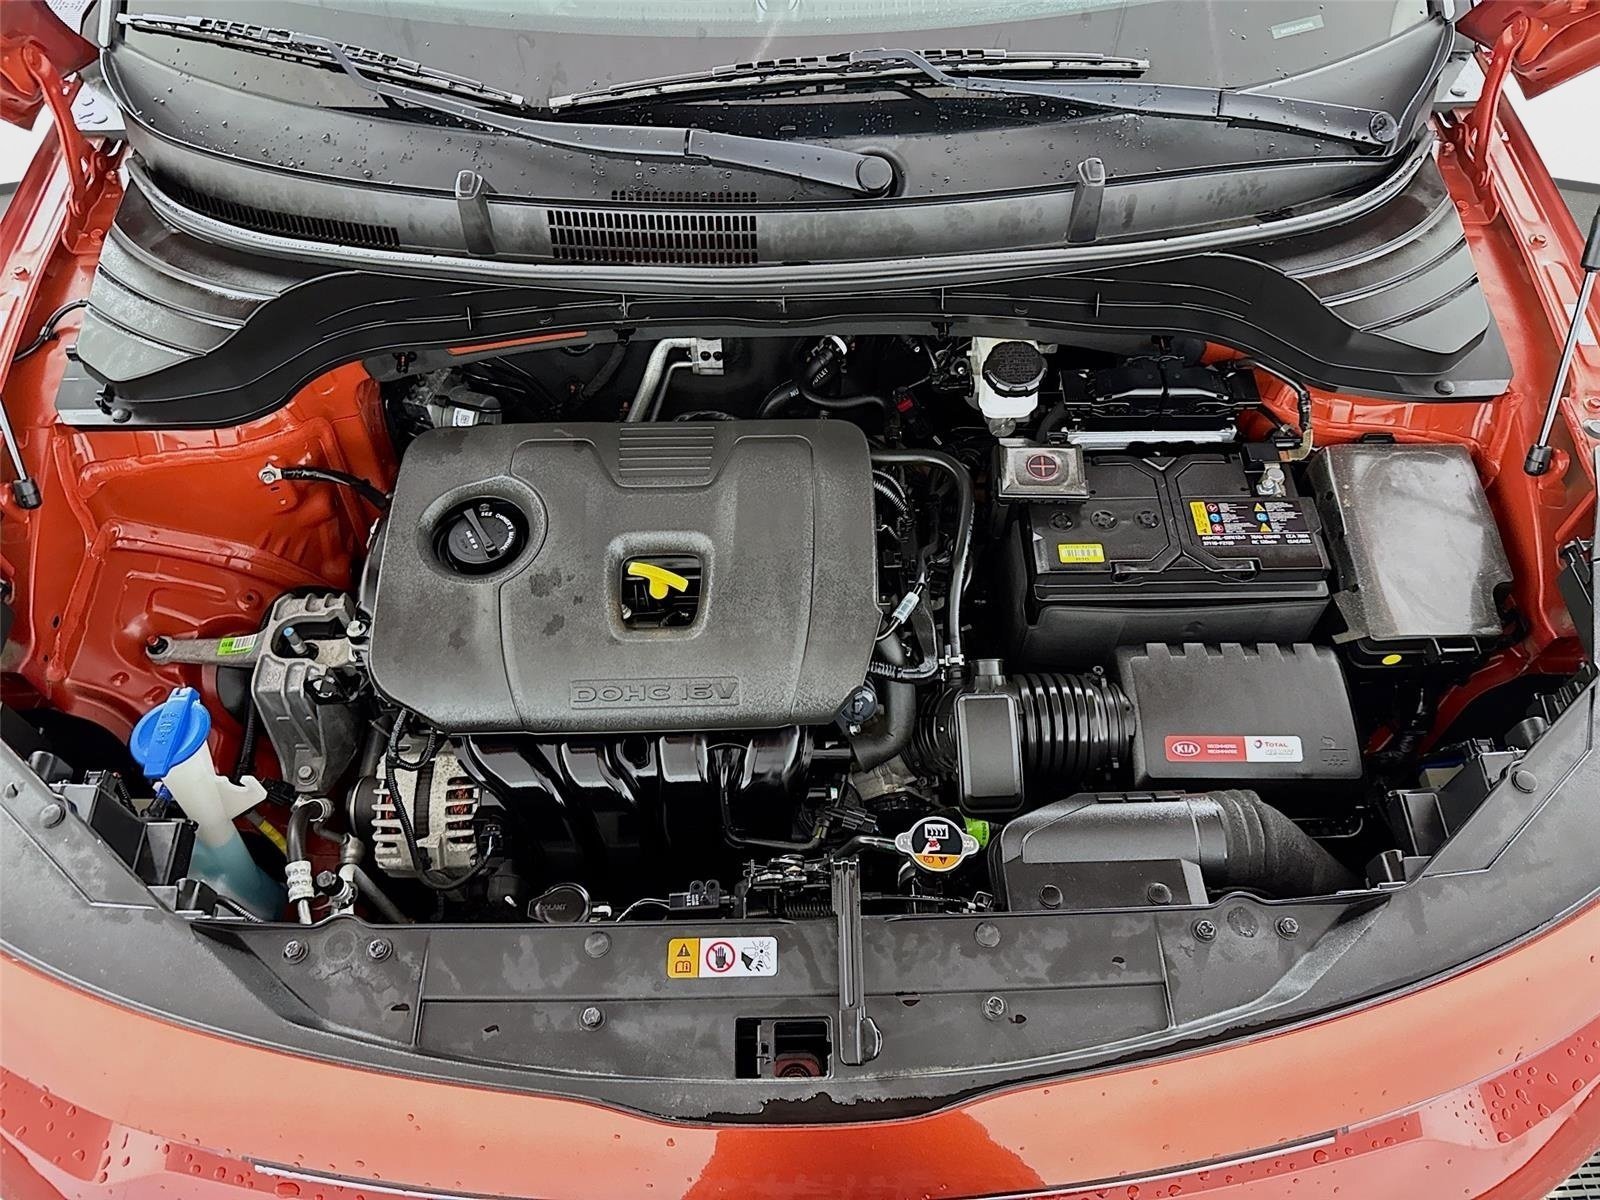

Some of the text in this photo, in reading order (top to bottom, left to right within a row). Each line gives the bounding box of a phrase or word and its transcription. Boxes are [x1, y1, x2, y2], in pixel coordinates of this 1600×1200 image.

[573, 682, 738, 702] DOHC 16V
[1176, 744, 1196, 754] KIA
